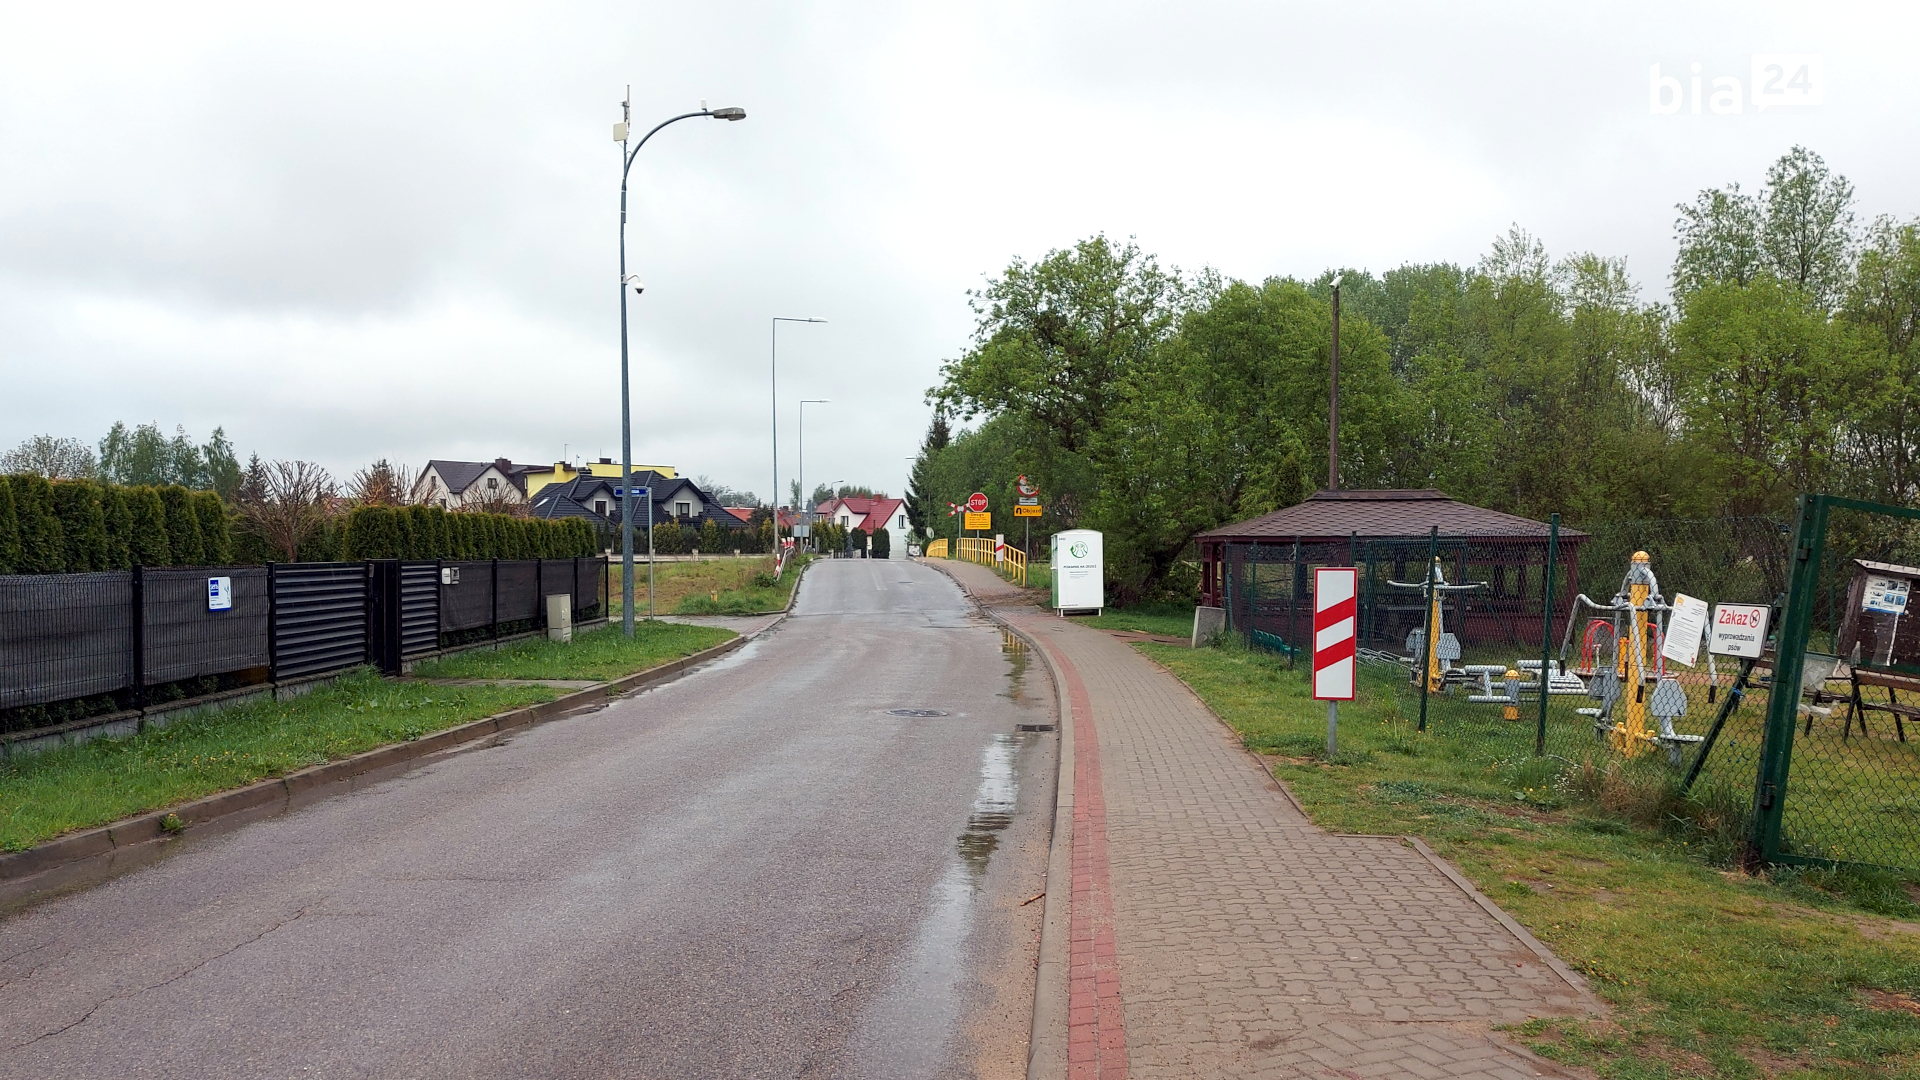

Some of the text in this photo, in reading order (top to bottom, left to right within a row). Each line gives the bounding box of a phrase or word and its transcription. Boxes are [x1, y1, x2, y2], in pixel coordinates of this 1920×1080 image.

[1022, 507, 1042, 515] Objazd
[1719, 609, 1748, 625] Zakaz
[1718, 632, 1755, 642] wyprowadzania
[1727, 643, 1742, 652] psów
